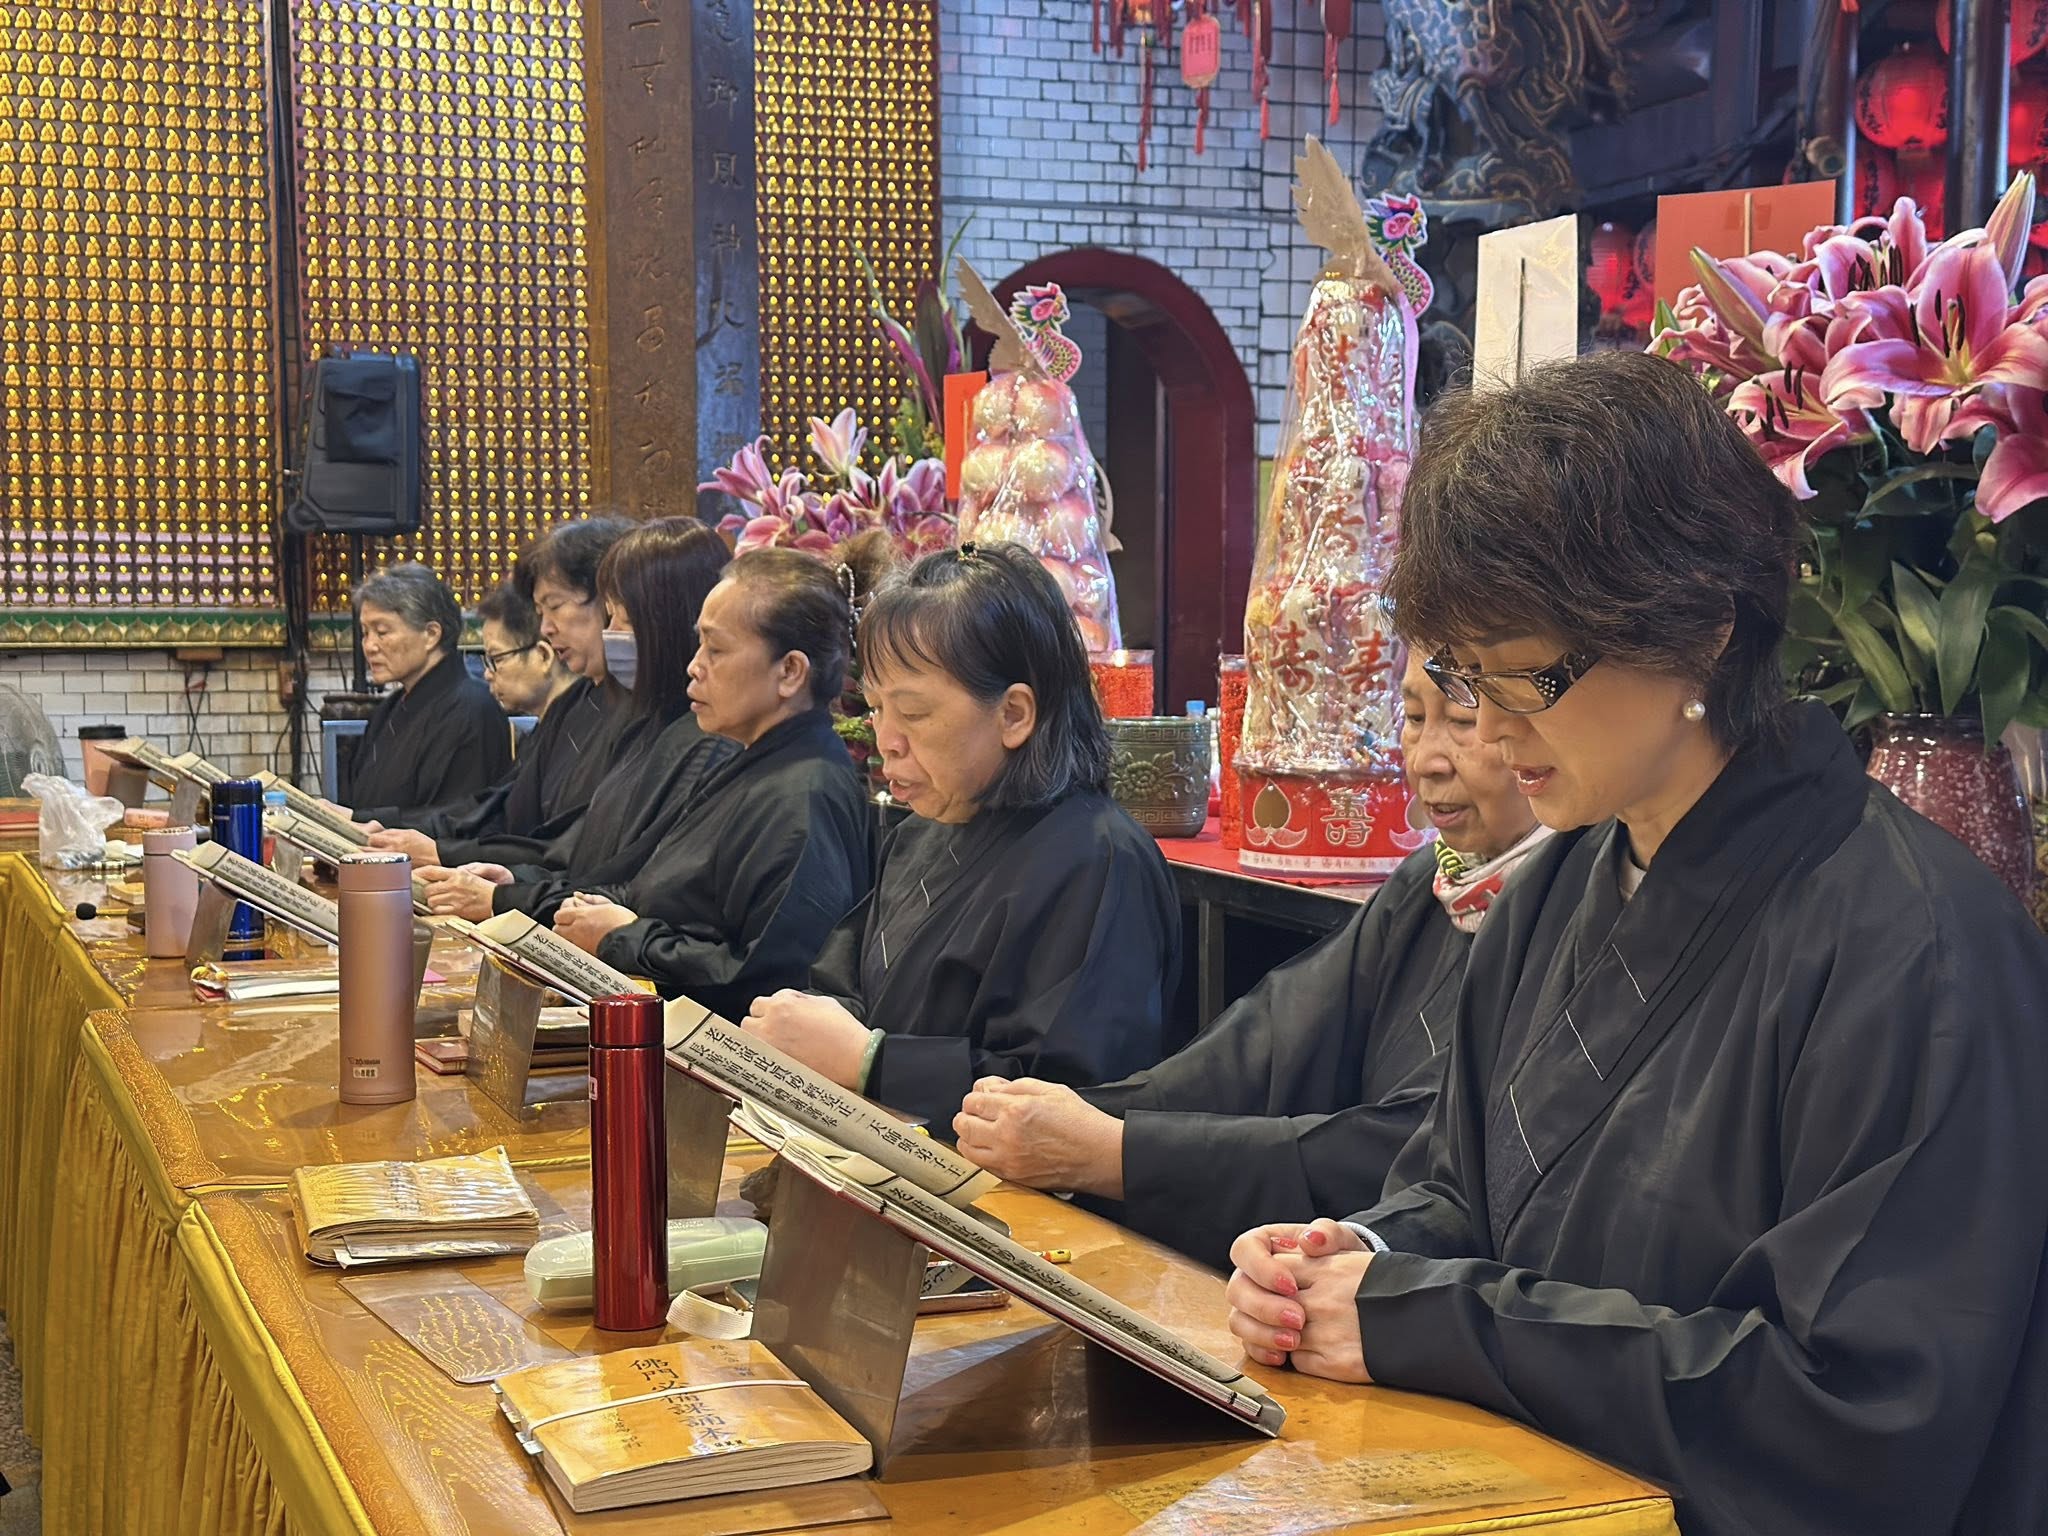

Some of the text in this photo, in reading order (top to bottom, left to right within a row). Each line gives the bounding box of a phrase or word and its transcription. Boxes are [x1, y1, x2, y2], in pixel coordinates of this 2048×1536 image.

[1320, 786, 1375, 847] 壽
[628, 1357, 737, 1440] 佛門必備課誦本
